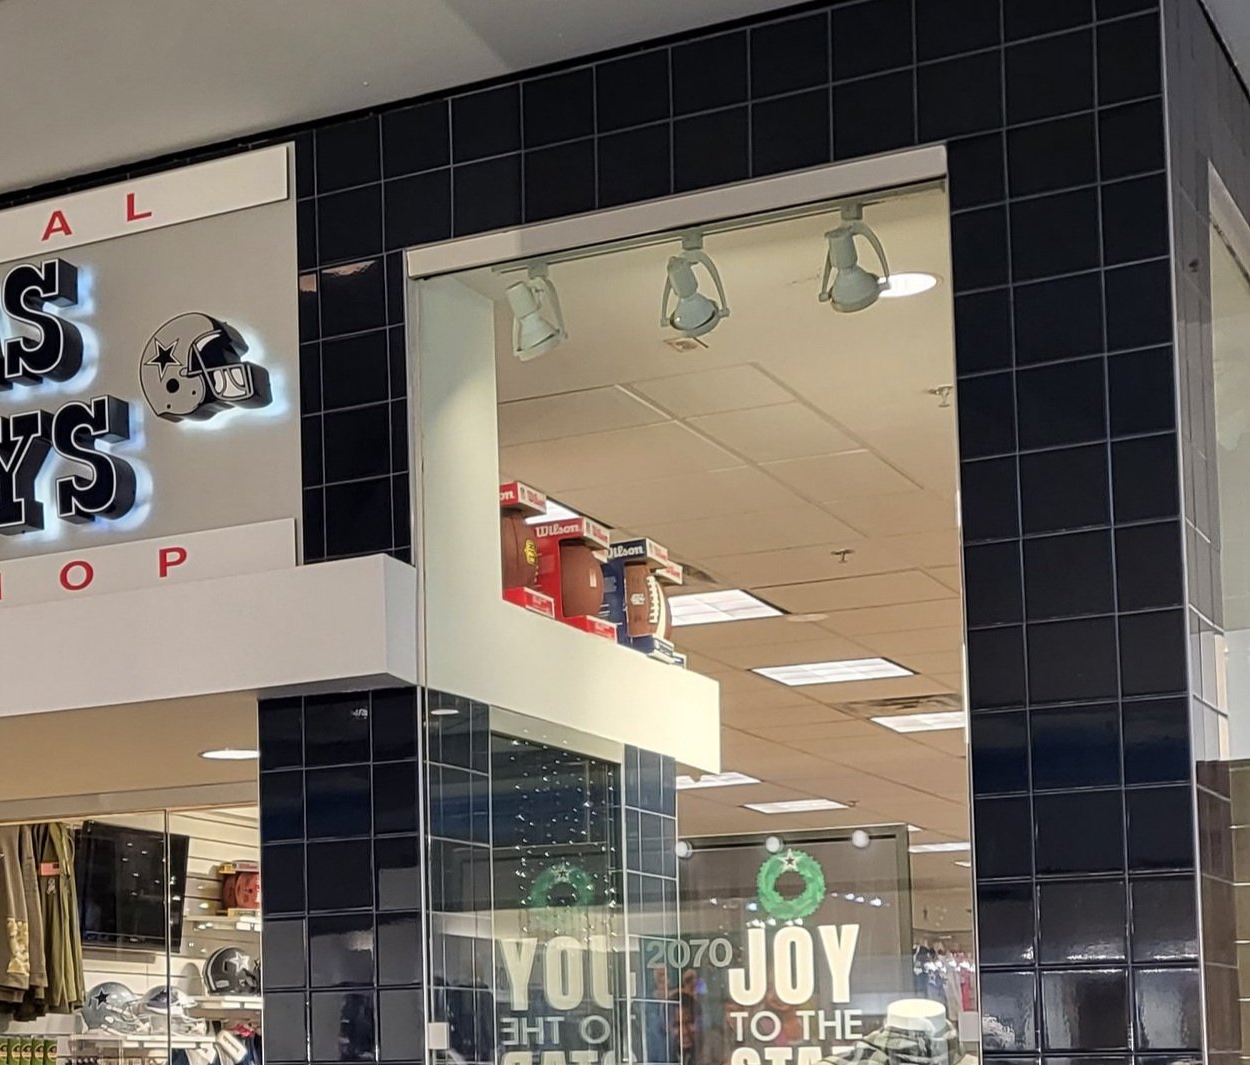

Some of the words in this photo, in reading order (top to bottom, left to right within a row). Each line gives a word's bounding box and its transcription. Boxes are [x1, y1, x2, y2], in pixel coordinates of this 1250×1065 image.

[535, 522, 581, 538] Wilson
[647, 938, 733, 969] 2070
[728, 924, 859, 1006] JOY
[729, 1010, 782, 1041] TO
[796, 1009, 863, 1040] THE
